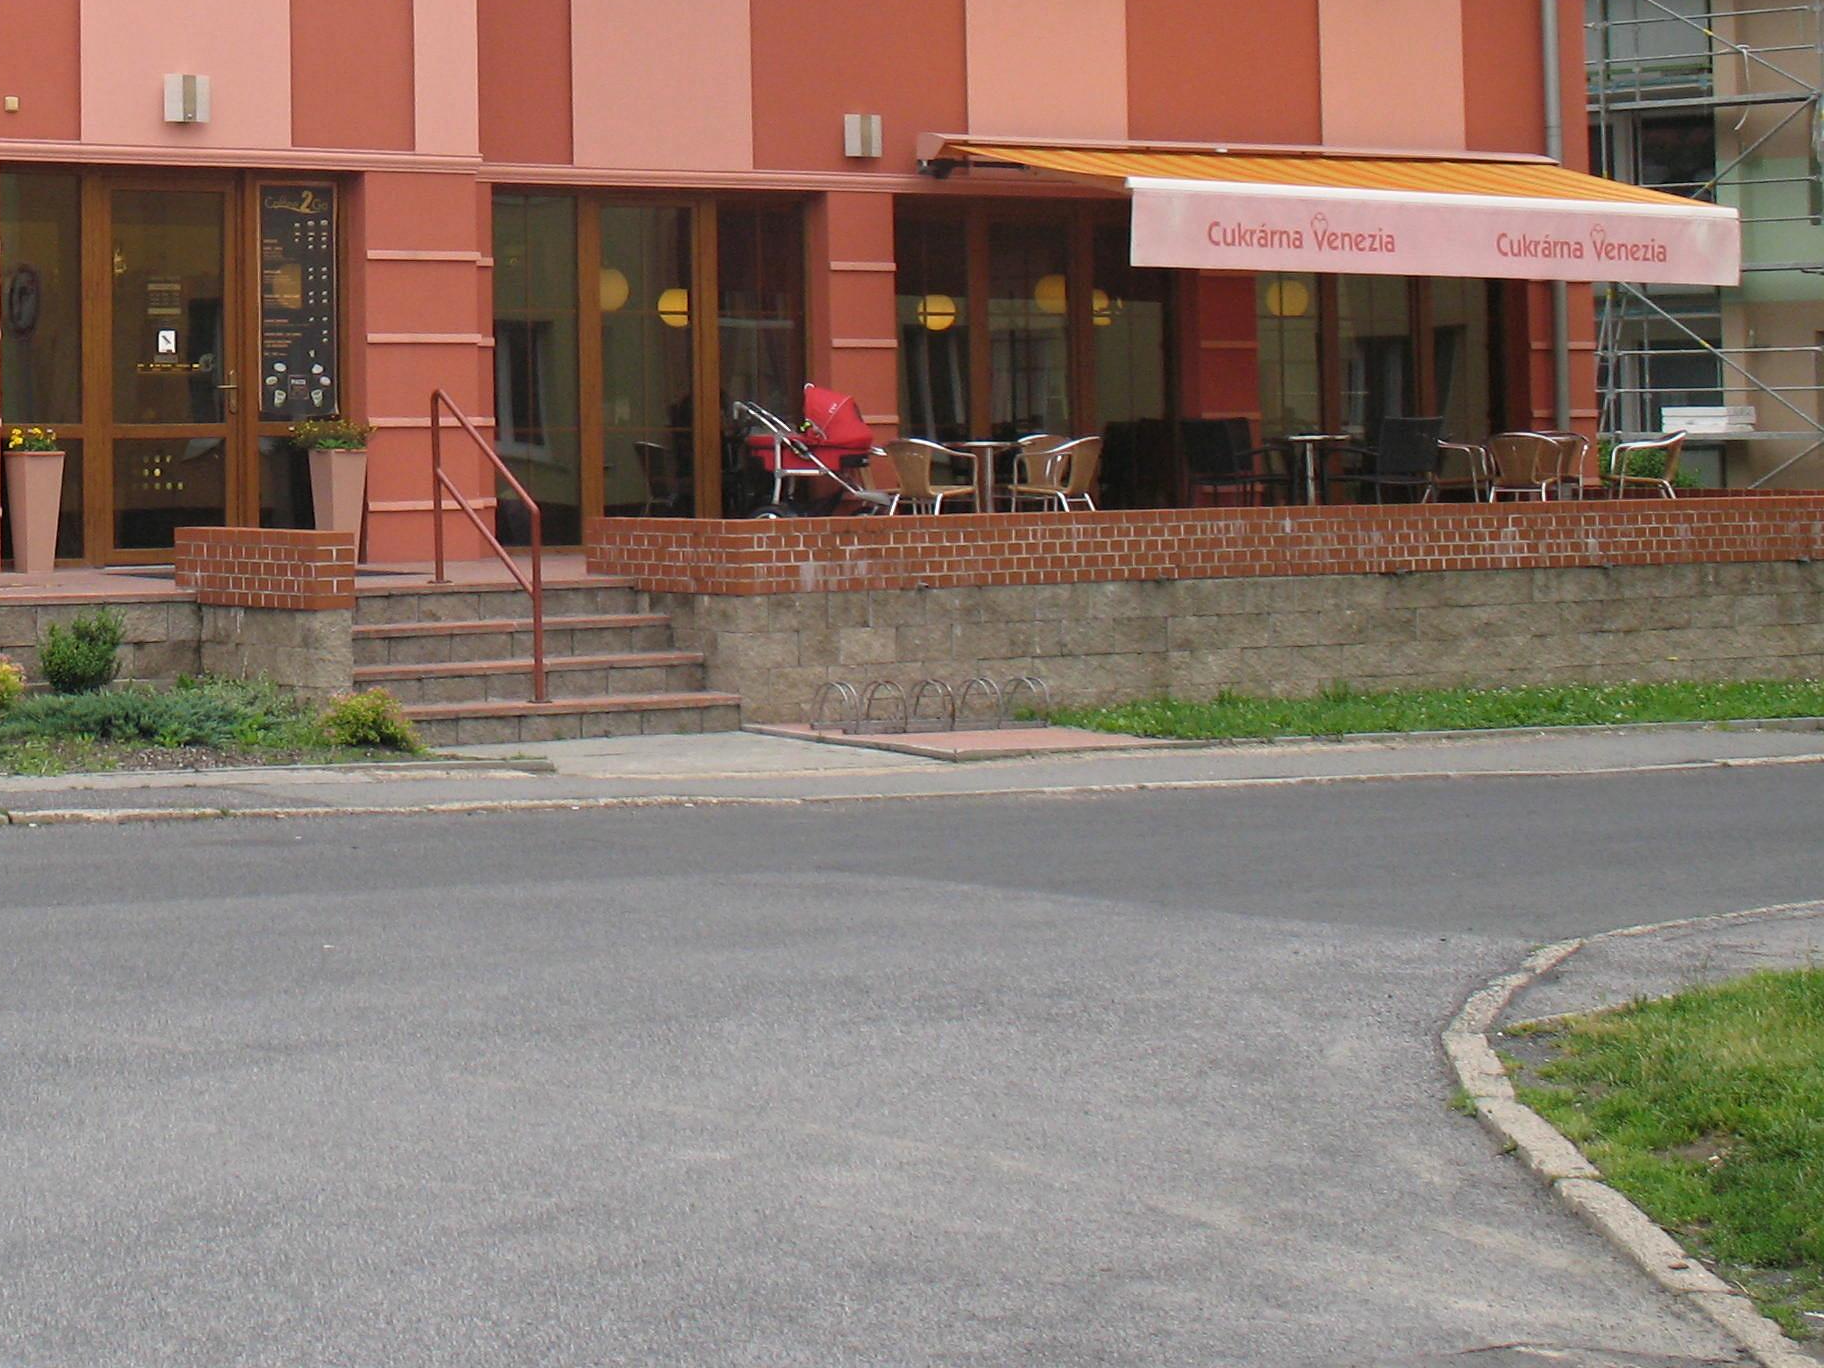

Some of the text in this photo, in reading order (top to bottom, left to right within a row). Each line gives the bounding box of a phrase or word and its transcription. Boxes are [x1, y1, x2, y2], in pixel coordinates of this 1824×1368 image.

[1207, 213, 1396, 253] Cukrárna Venezia
[1496, 224, 1668, 263] Cukrárna Venezia
